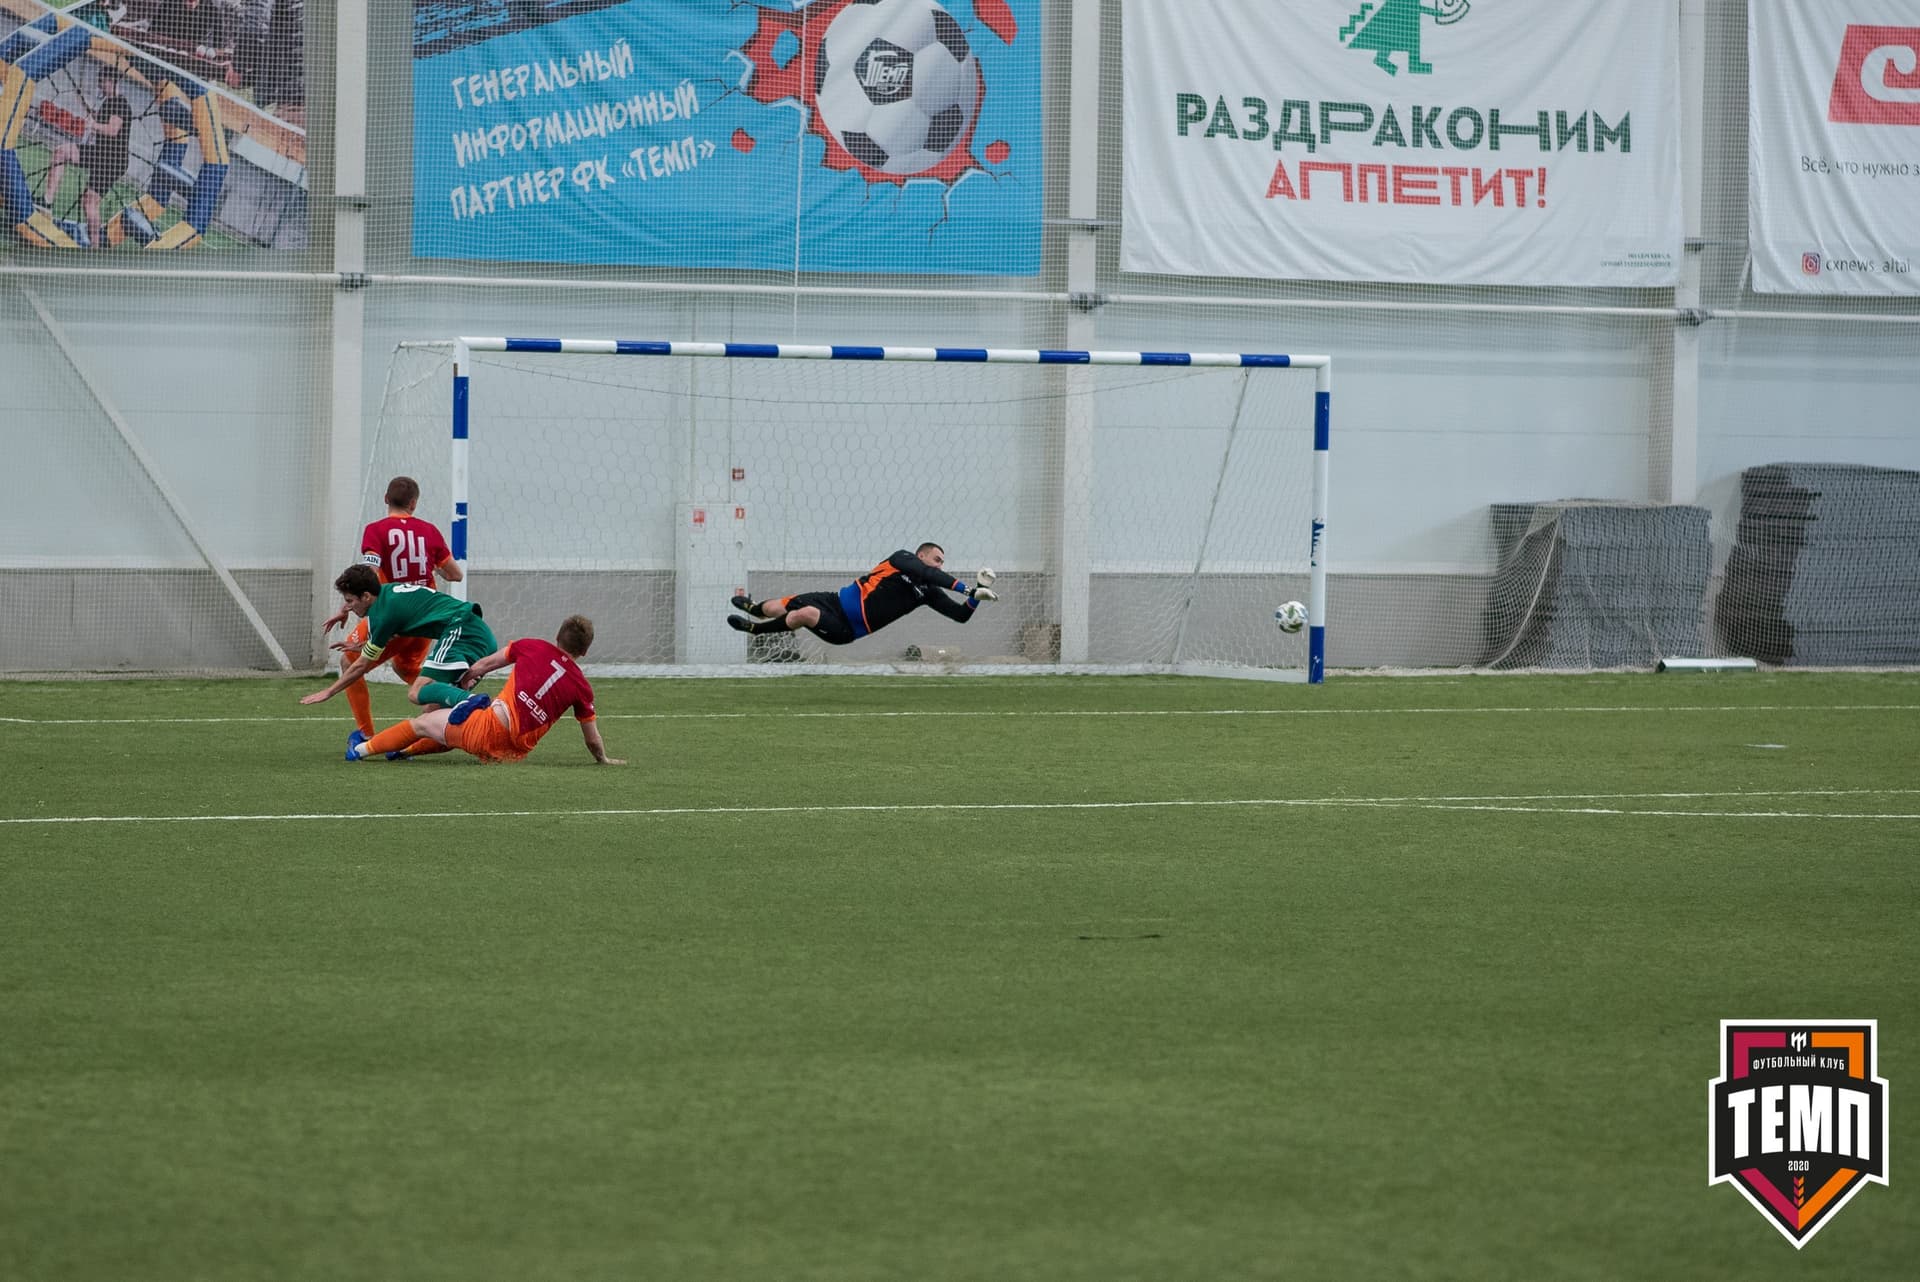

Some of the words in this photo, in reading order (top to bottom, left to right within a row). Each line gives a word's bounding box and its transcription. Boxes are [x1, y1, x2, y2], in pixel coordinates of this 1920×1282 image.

[452, 38, 634, 110] ГЕНЕРАЛЬНЫЙ
[453, 78, 699, 168] ИНФОРМАЦИОННЫЙ
[1176, 93, 1631, 153] РАЗДРАКОНИМ
[451, 166, 565, 220] ПАРТНЕР
[572, 154, 616, 193] ФК
[621, 136, 716, 181] «ТЕМП»
[1265, 159, 1547, 208] АППЕТИТ!
[1801, 156, 1830, 174] Всё,
[1835, 161, 1859, 175] что
[1862, 162, 1909, 179] нужно
[387, 528, 428, 579] 24
[535, 660, 566, 699] 7
[517, 690, 549, 722] SEUS
